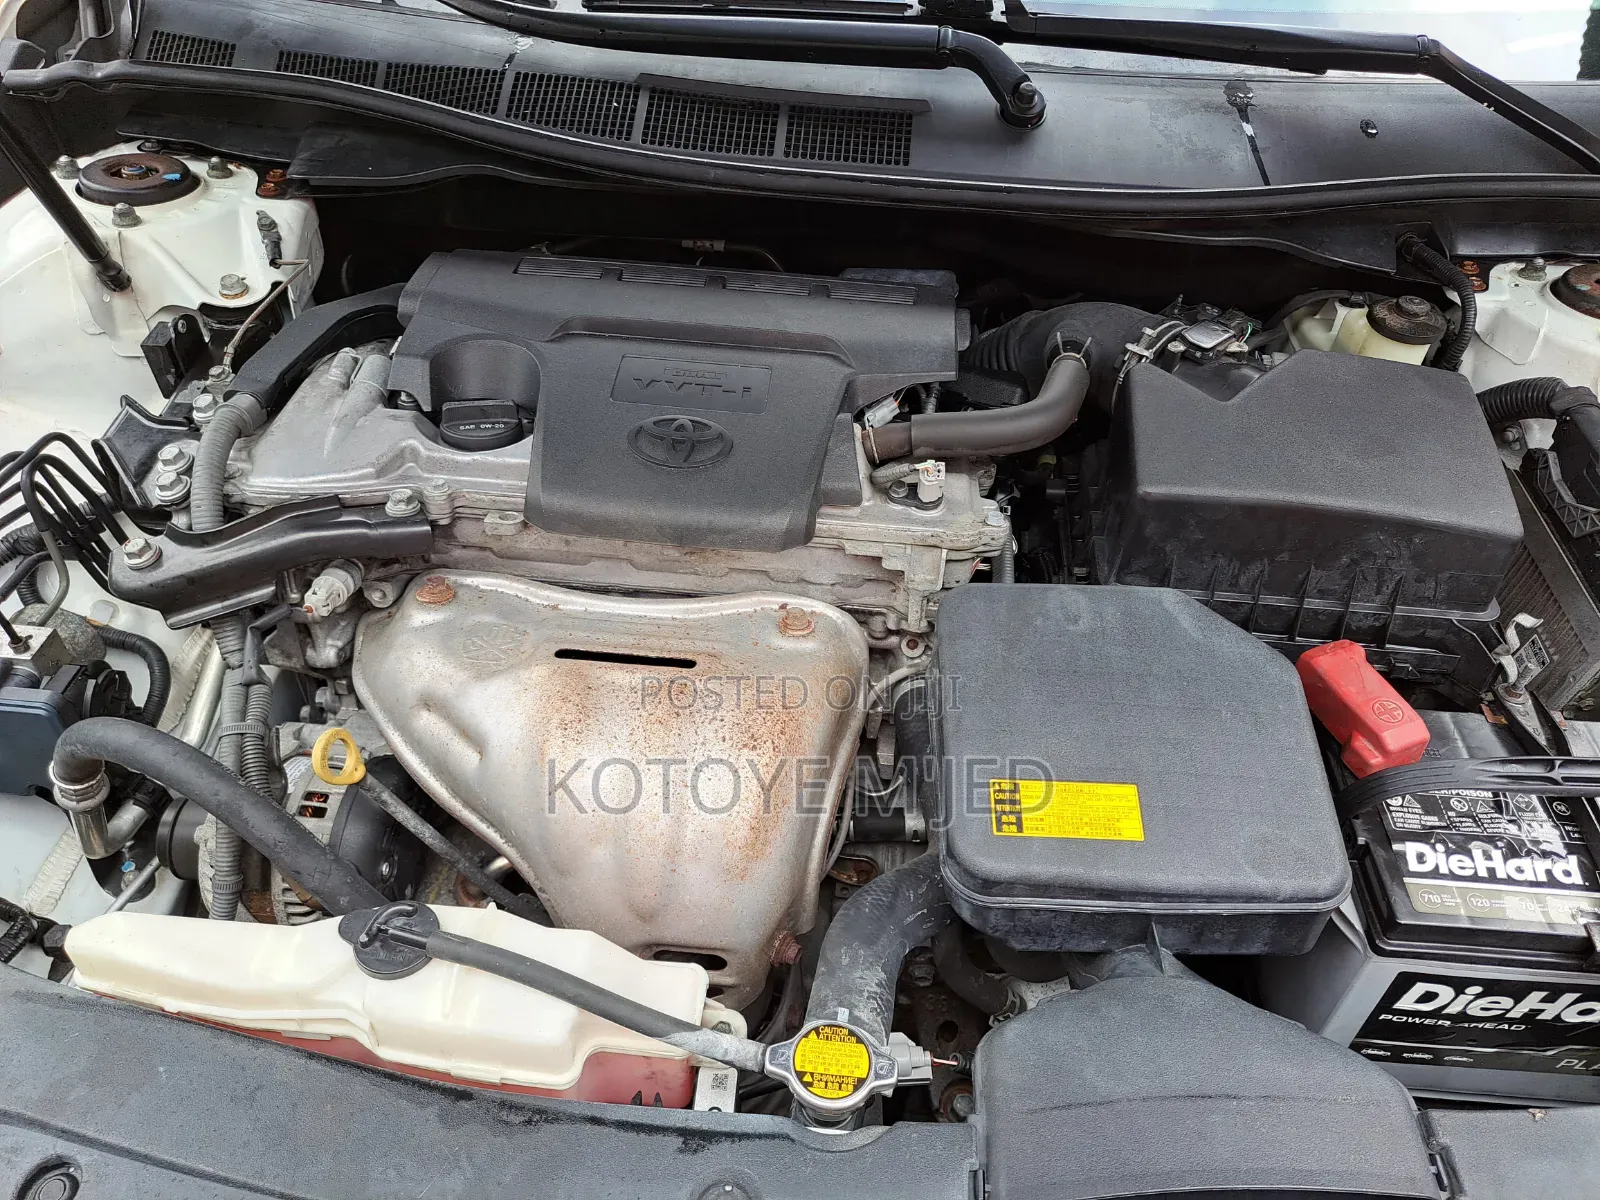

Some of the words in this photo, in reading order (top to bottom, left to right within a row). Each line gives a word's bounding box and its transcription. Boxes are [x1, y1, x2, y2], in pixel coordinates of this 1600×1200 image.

[994, 792, 1020, 800] CAUTION
[996, 804, 1020, 812] ATTENTION
[1404, 841, 1585, 886] DieHard
[1421, 892, 1441, 904] 710
[1470, 897, 1490, 908] 120
[1520, 901, 1535, 911] 70
[1378, 1014, 1451, 1028] POWER
[1454, 1021, 1526, 1031] AHEAD
[819, 1026, 849, 1035] CAUTION
[818, 1033, 857, 1043] ATTENTION
[813, 1073, 858, 1085] ВНИМАНИЕ!
